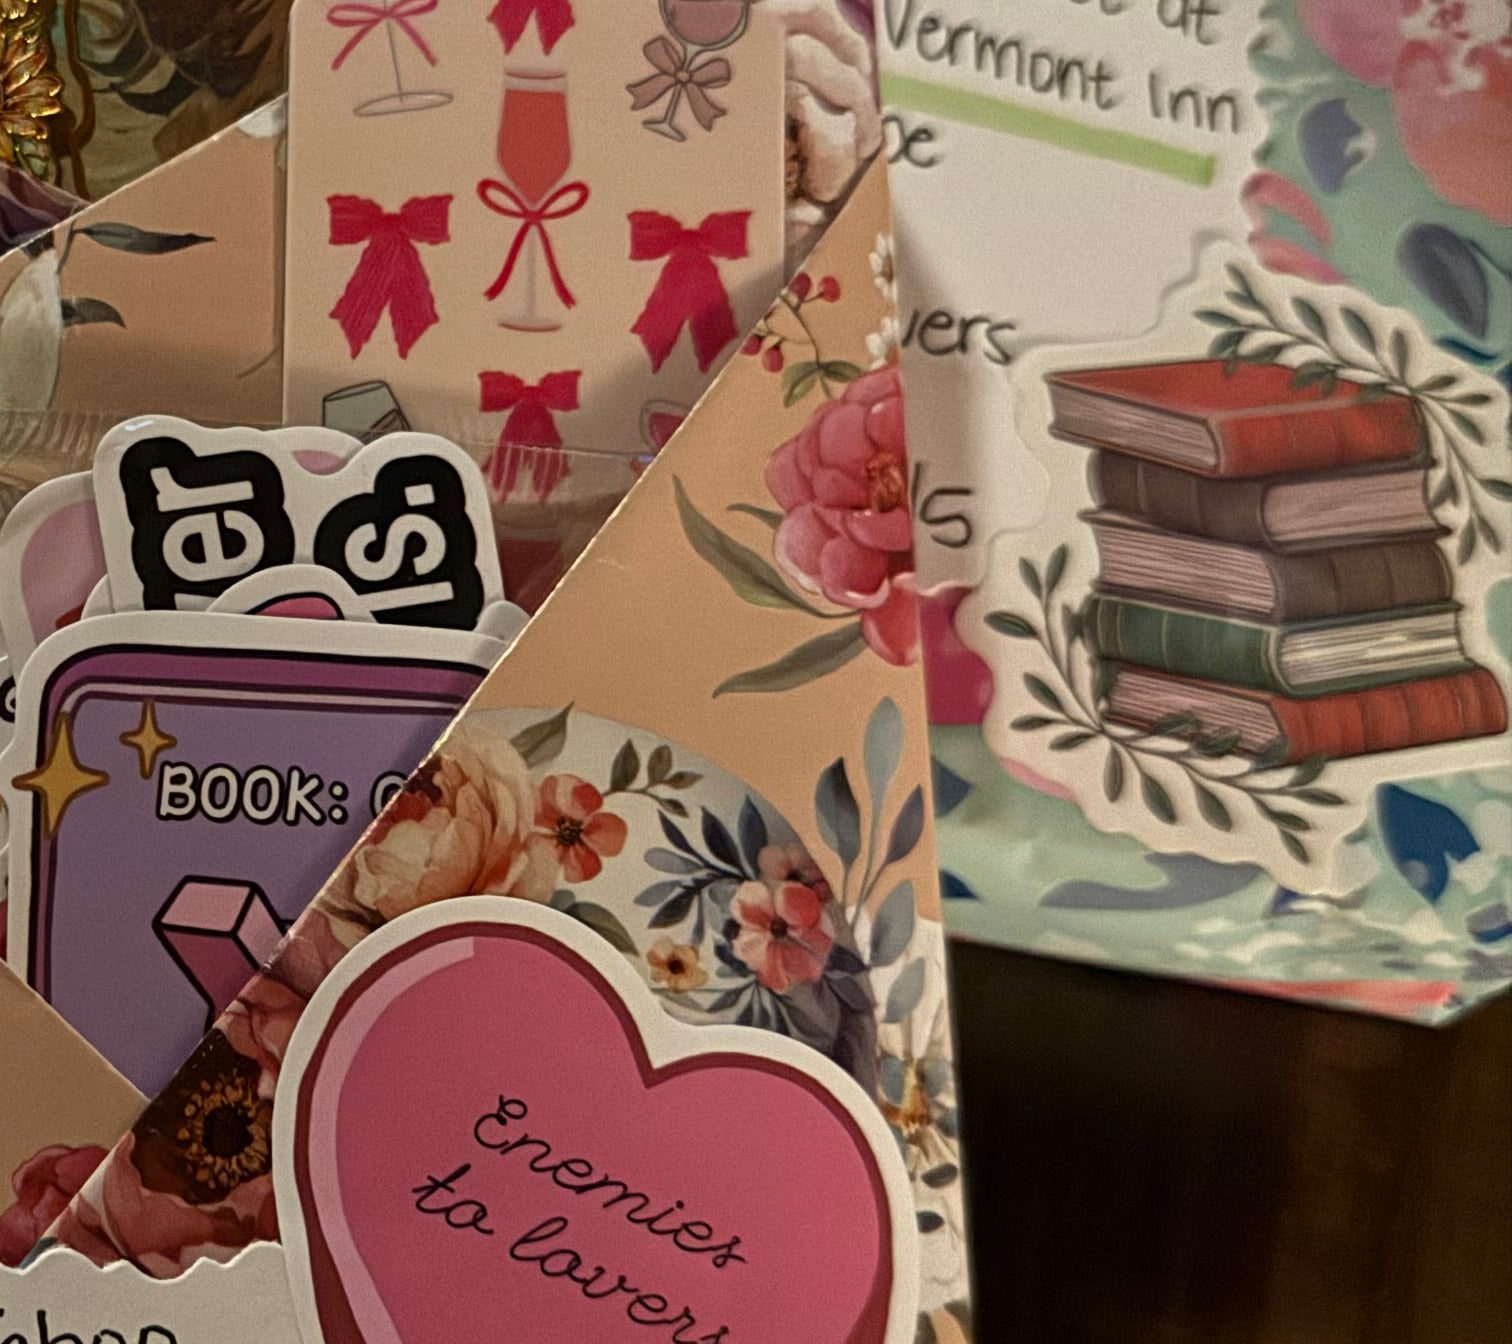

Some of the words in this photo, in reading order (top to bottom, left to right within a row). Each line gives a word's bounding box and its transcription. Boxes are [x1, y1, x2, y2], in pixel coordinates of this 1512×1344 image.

[1146, 69, 1242, 135] Inn
[157, 760, 349, 824] BOOK:
[412, 1161, 494, 1236] to
[473, 1093, 747, 1269] Enemies
